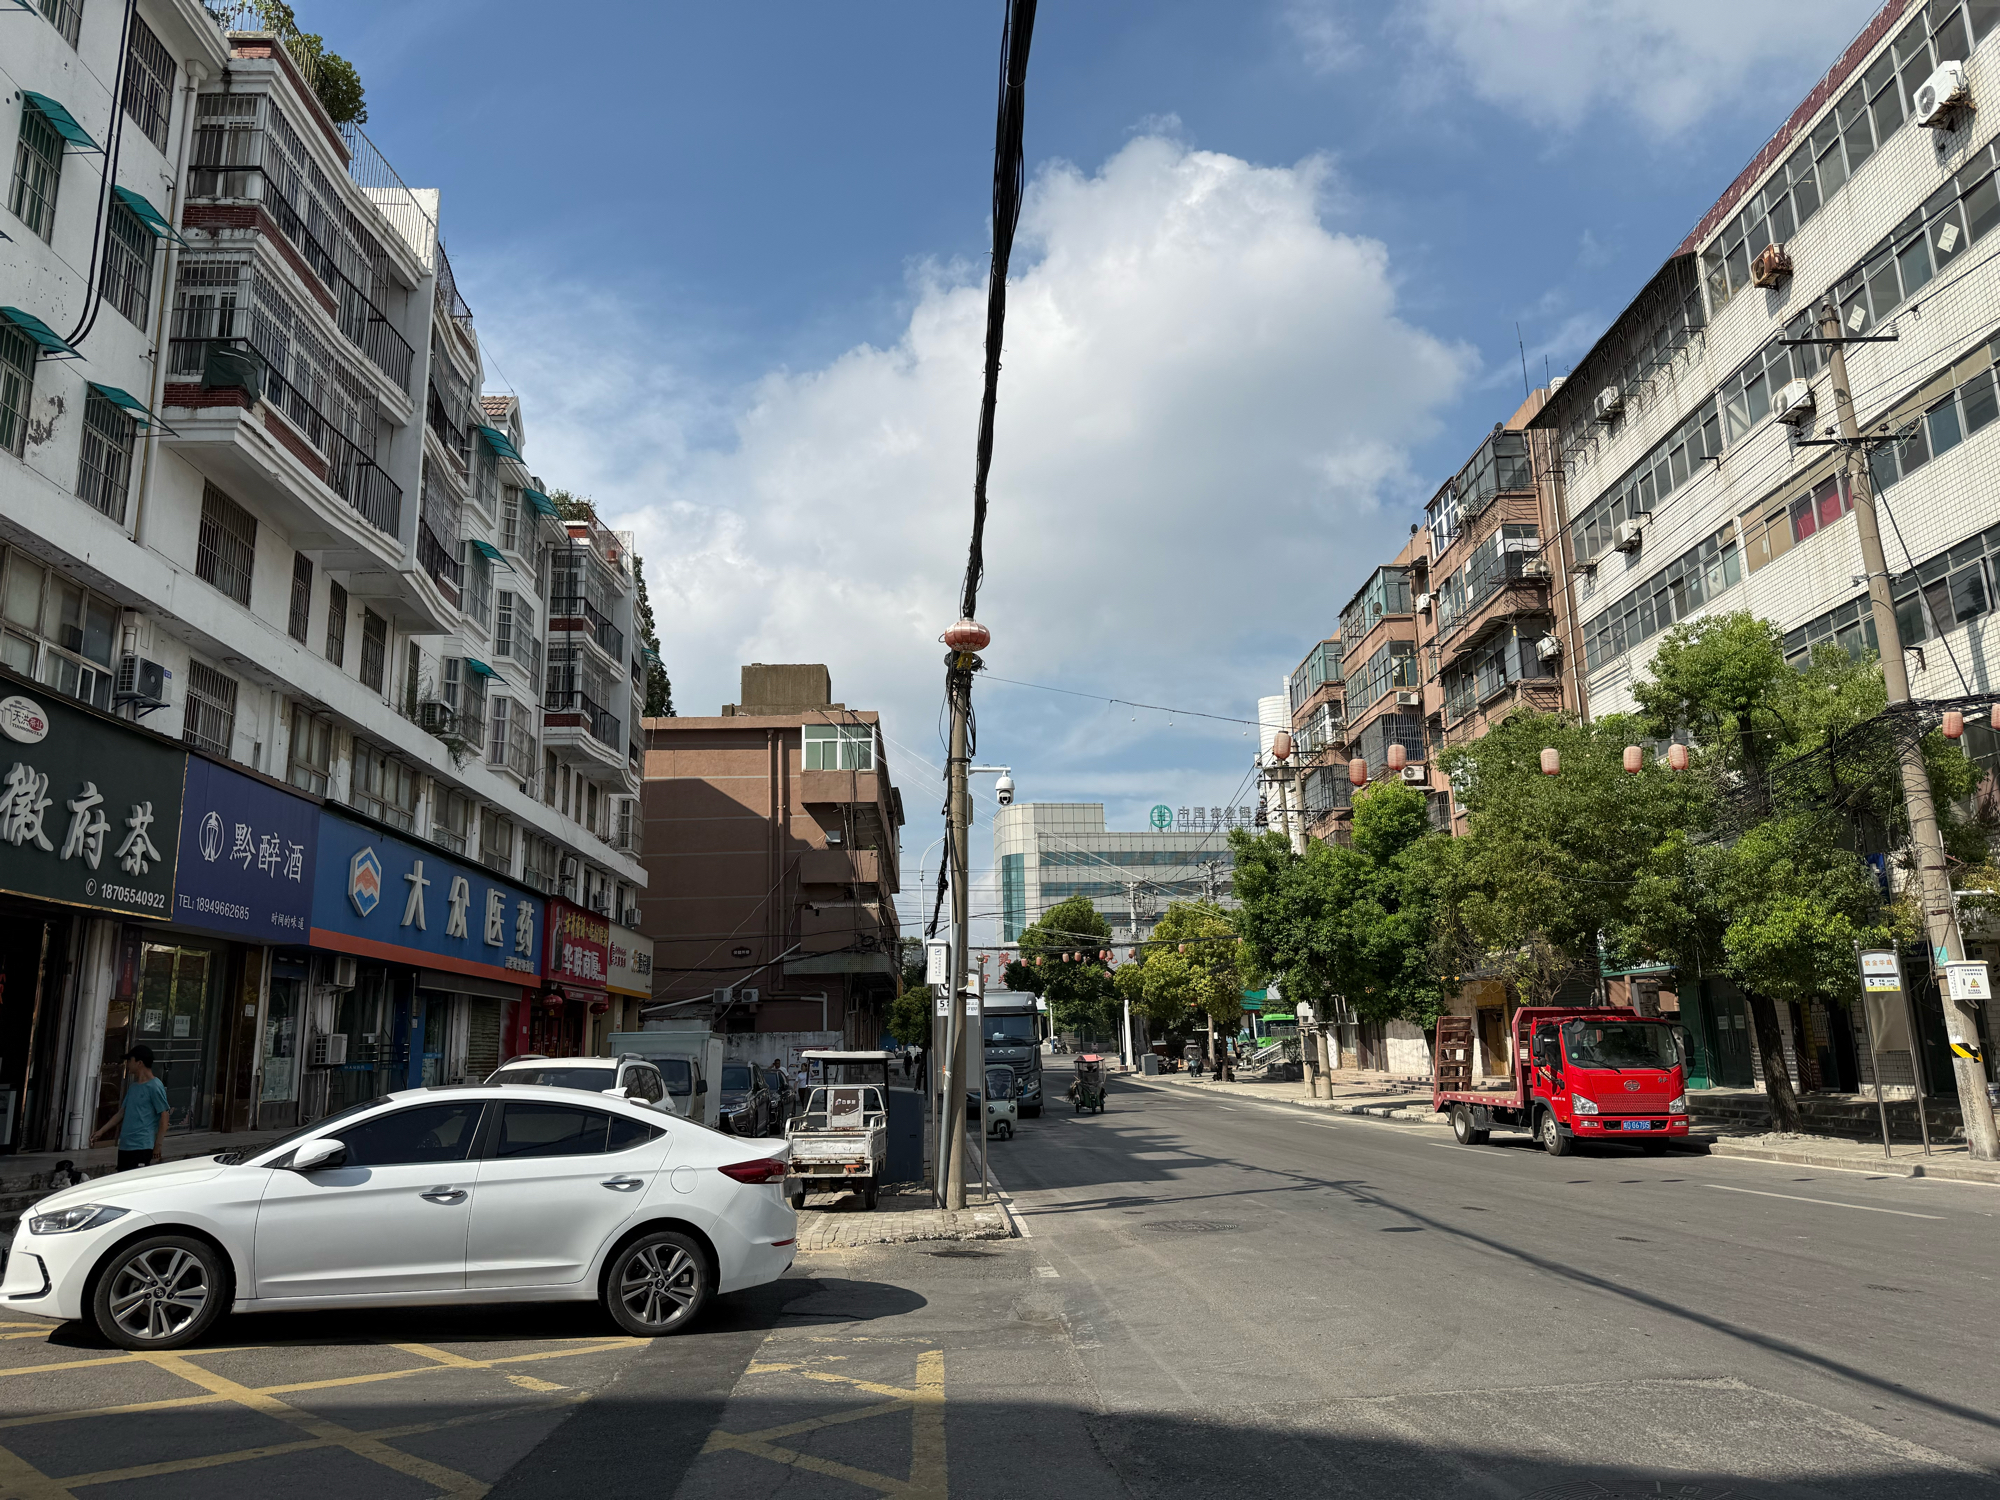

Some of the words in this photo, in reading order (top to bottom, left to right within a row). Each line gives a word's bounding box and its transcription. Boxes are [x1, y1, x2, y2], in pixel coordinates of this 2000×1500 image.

[0, 762, 162, 877] 徽府茶
[229, 822, 305, 884] 黔醉酒
[101, 883, 165, 908] 18705540922
[196, 897, 250, 921] 18949662685
[400, 859, 535, 957] 大众医药
[271, 911, 305, 931] 时间的味道
[563, 943, 601, 981] 华联商厦
[987, 1049, 1016, 1057] JAC
